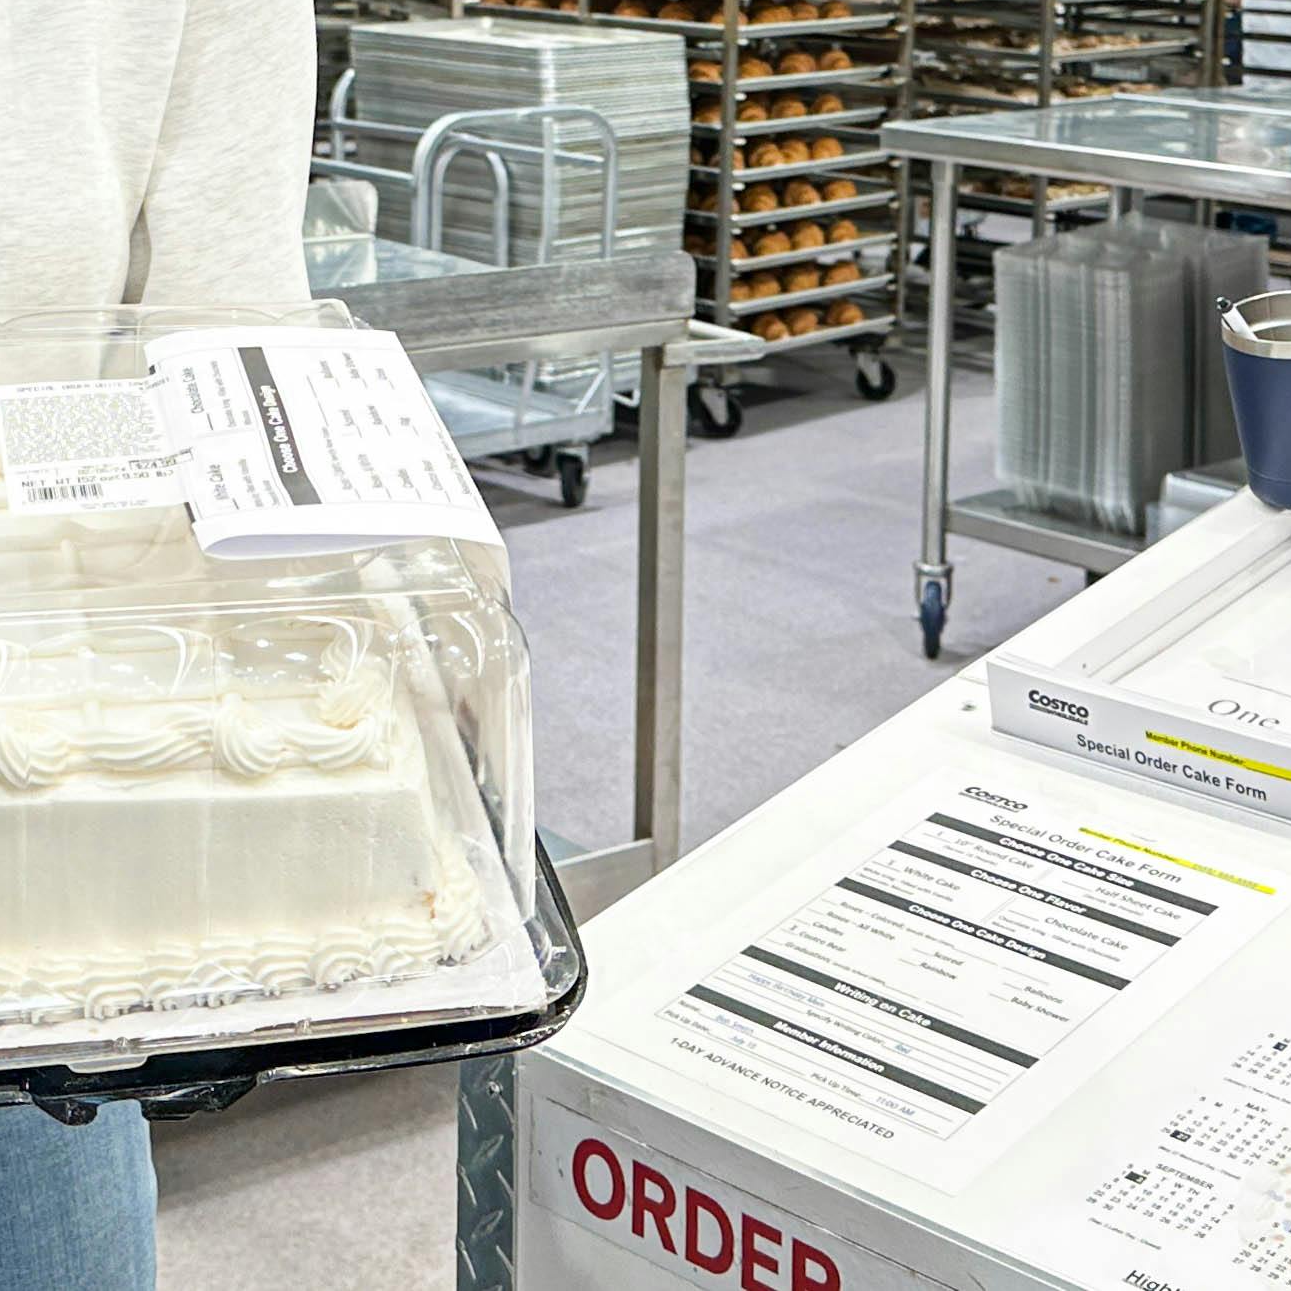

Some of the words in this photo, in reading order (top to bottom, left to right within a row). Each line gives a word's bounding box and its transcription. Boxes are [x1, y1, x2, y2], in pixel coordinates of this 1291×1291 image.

[274, 426, 290, 442] One
[279, 443, 298, 473] Choose
[1029, 689, 1089, 719] COSTCO
[1208, 699, 1281, 730] One
[1076, 734, 1130, 760] Special
[1135, 751, 1178, 774] Order
[1183, 766, 1221, 787] Cake
[1225, 777, 1267, 801] Form
[1181, 741, 1208, 755] Phone
[962, 786, 1028, 811] COSTCO
[989, 814, 1046, 841] Special
[1048, 833, 1094, 854] Order
[1095, 849, 1136, 868] Cake
[1138, 862, 1182, 883] Form
[998, 837, 1046, 858] Choose
[1046, 851, 1074, 866] One
[1073, 859, 1106, 878] Cake
[1106, 872, 1135, 887] Size
[970, 869, 1018, 892] Choose
[1018, 883, 1046, 900] One
[1045, 893, 1087, 914] Flavor
[908, 904, 951, 926] Choose
[951, 918, 975, 934] One
[975, 926, 1005, 944] Cake
[1005, 938, 1046, 960] Design
[834, 982, 879, 1008] Writing
[879, 999, 899, 1013] on
[897, 1006, 931, 1027] Cake
[772, 1021, 818, 1047] Member
[818, 1039, 885, 1073] Information
[670, 1037, 705, 1056] 1-DAY
[706, 1052, 760, 1081] ADVANCE
[760, 1077, 807, 1103] NOTICE
[806, 1098, 895, 1140] APPRECIATED
[1156, 1164, 1214, 1190] SEPTEMBER
